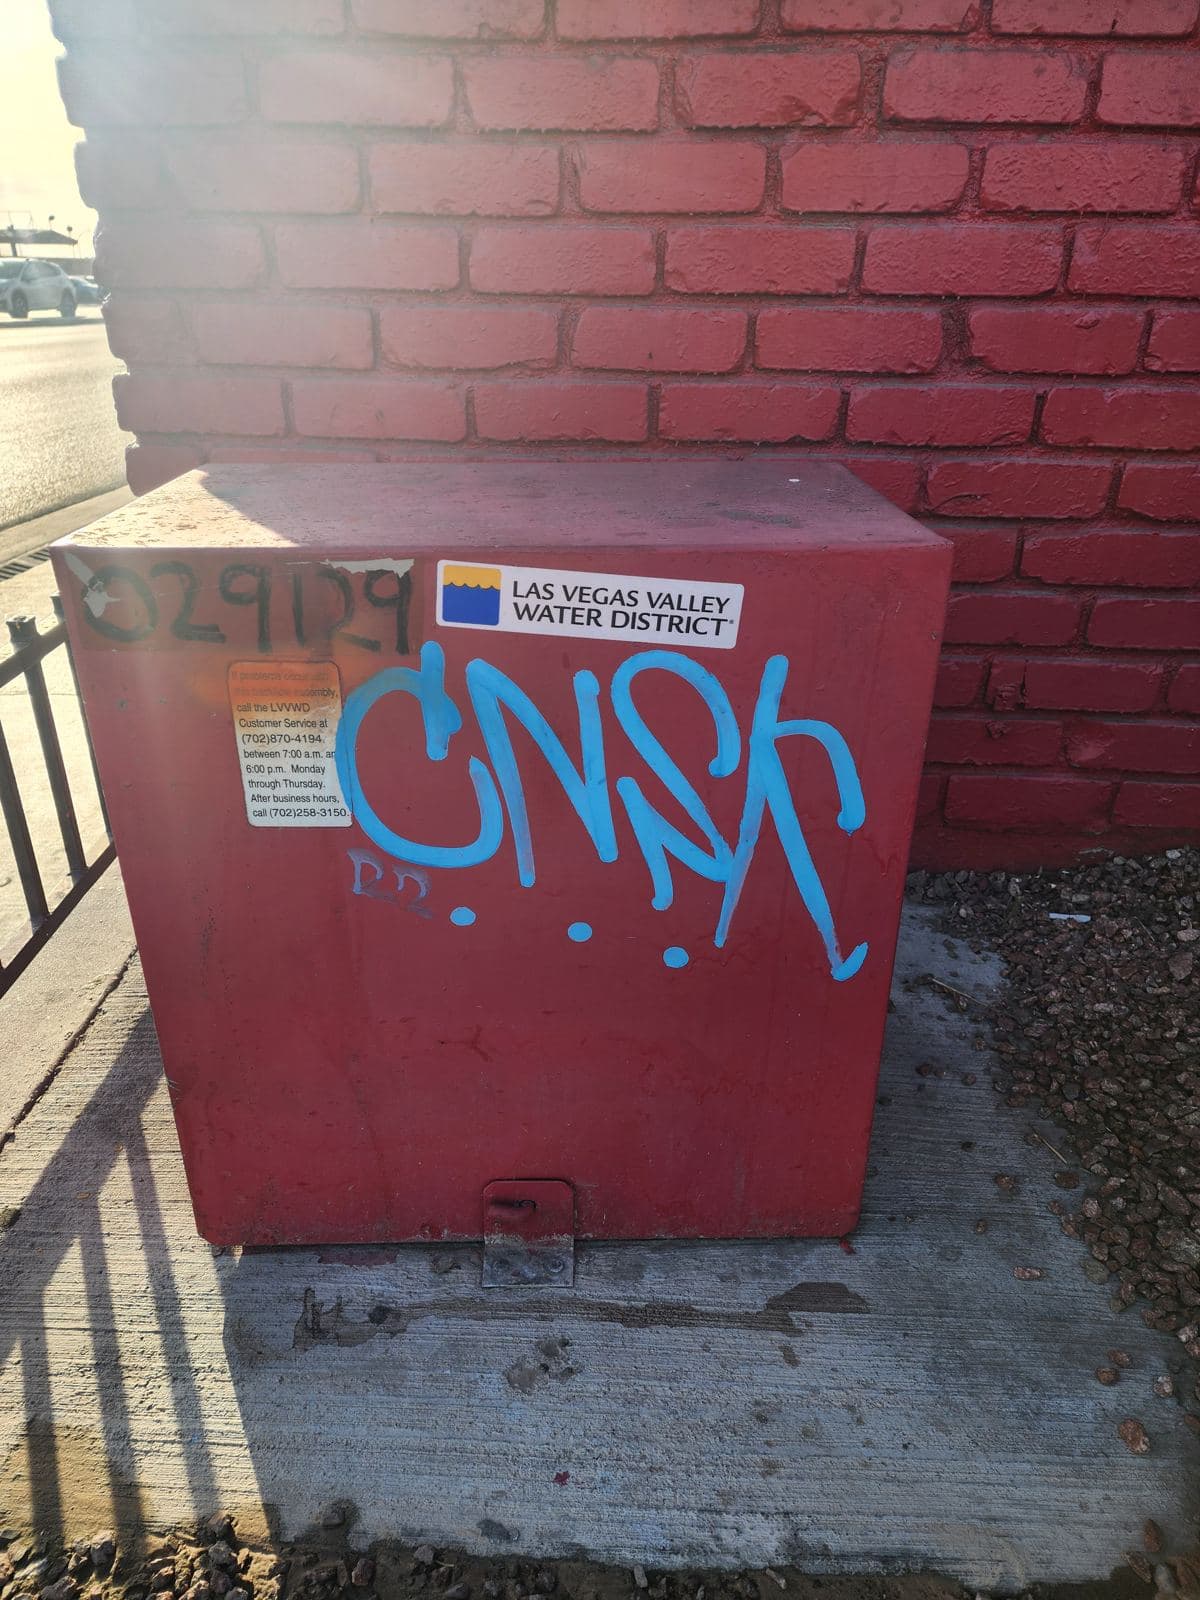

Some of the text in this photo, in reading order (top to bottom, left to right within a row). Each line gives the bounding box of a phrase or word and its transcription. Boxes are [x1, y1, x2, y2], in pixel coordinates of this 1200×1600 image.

[512, 580, 731, 614] LAS VEGAS VALLEY
[512, 602, 727, 636] WATER DISTRICT
[237, 702, 311, 713] call the LVVWD
[239, 718, 328, 728] Customer Service at
[244, 750, 280, 759] between
[283, 750, 302, 759] 7:00
[304, 751, 323, 759] a.m.
[246, 764, 326, 775] 6:00 p.m. Monday
[248, 779, 326, 790] through Thursday.
[251, 793, 340, 804] After business hours,
[253, 808, 267, 817] call
